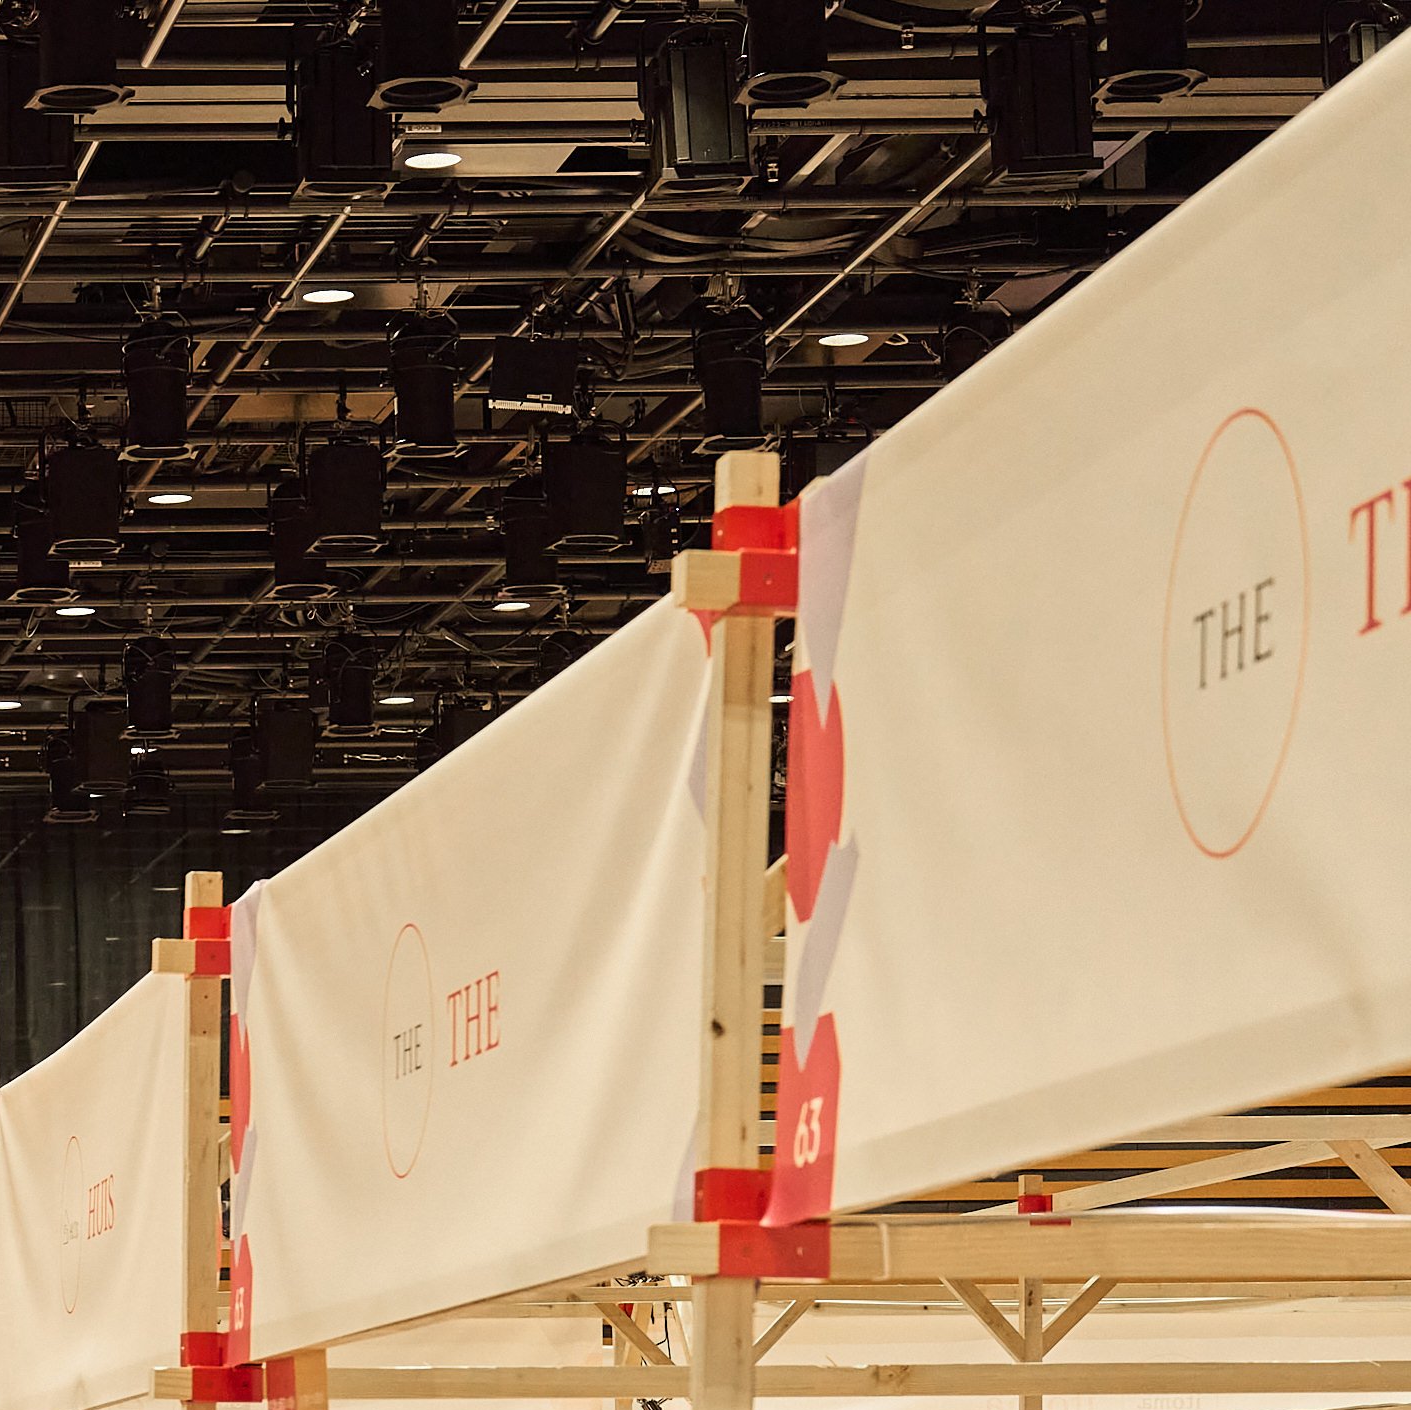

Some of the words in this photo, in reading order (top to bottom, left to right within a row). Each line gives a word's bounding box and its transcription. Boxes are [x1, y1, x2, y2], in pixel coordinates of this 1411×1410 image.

[1348, 476, 1411, 636] T
[1192, 576, 1276, 690] THE
[392, 1022, 423, 1081] THE
[447, 968, 500, 1070] THE
[792, 1096, 823, 1169] 63
[86, 1173, 115, 1241] HUIS
